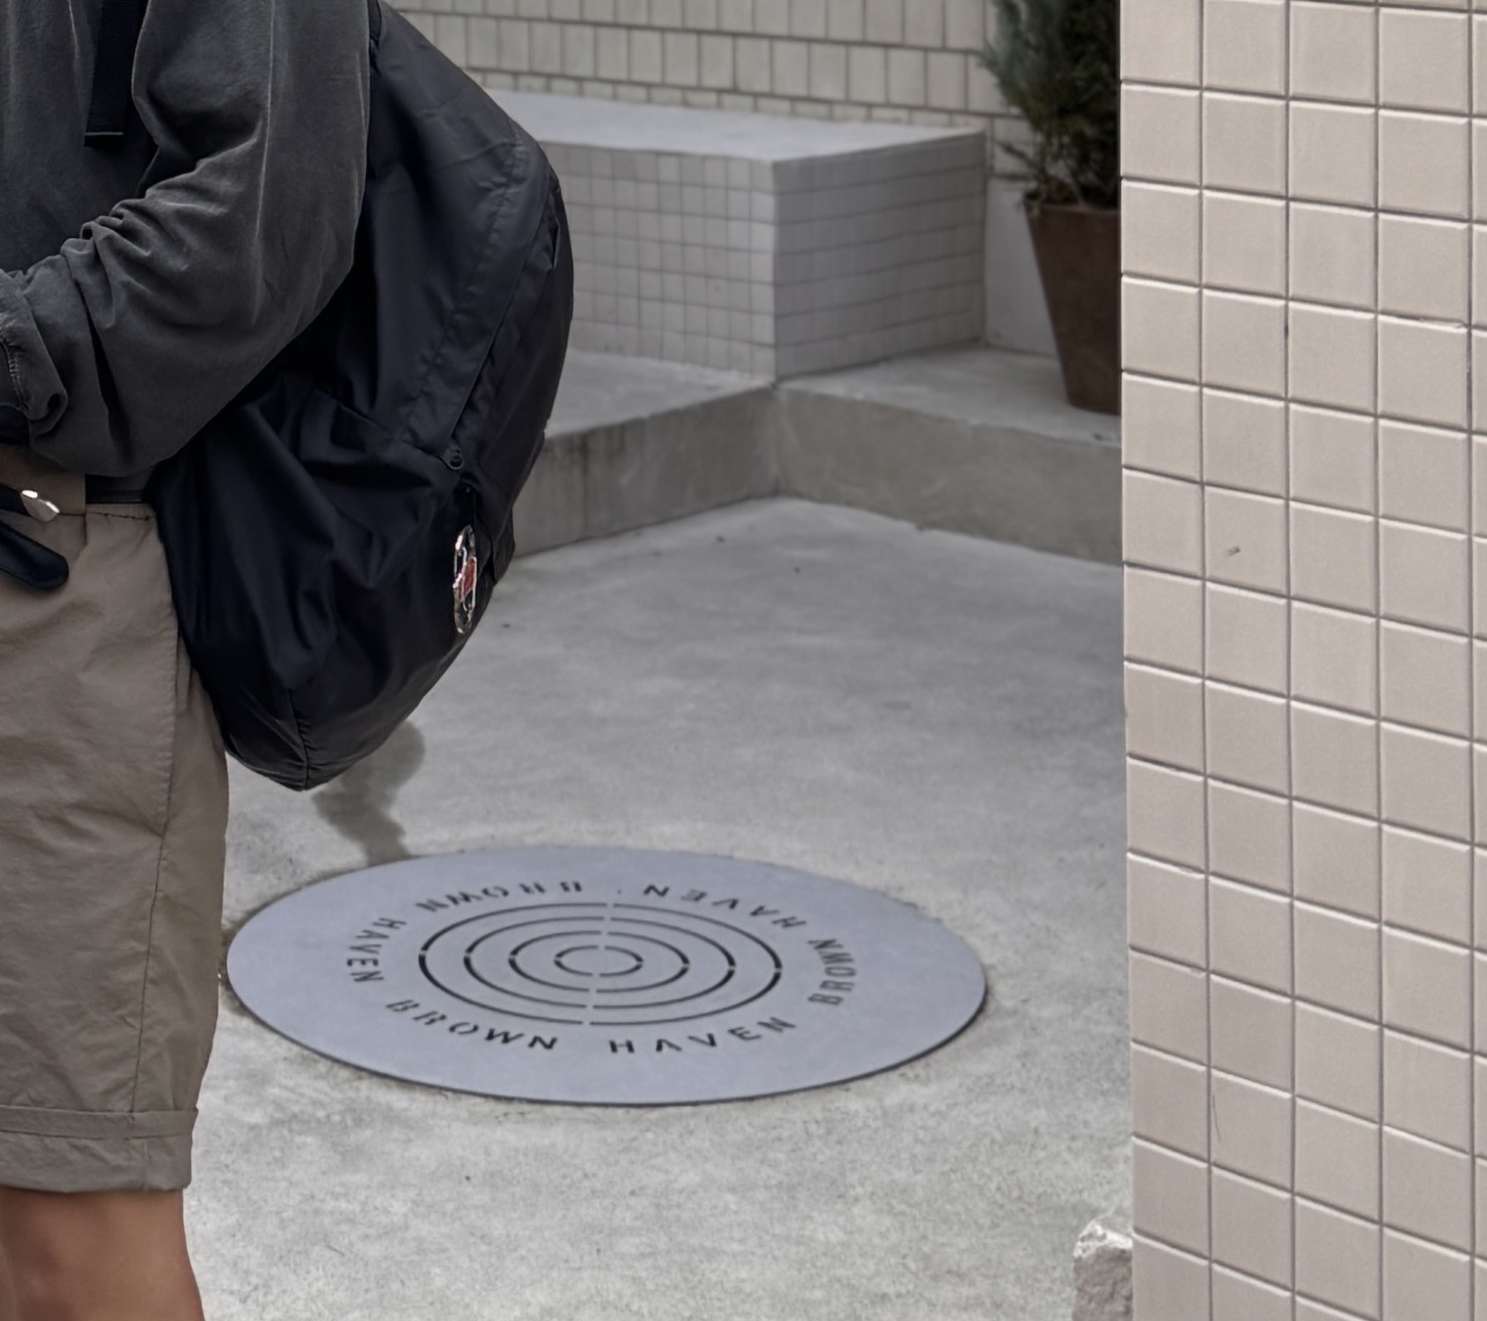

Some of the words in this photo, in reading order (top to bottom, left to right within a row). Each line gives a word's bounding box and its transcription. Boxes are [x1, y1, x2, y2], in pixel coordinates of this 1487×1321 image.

[415, 881, 582, 912] BROWN
[643, 884, 806, 928] HAVEN
[347, 917, 407, 982] HAVEN
[807, 938, 858, 1006] BROWN
[386, 999, 558, 1051] BROWN
[608, 1016, 797, 1054] HAVEN
